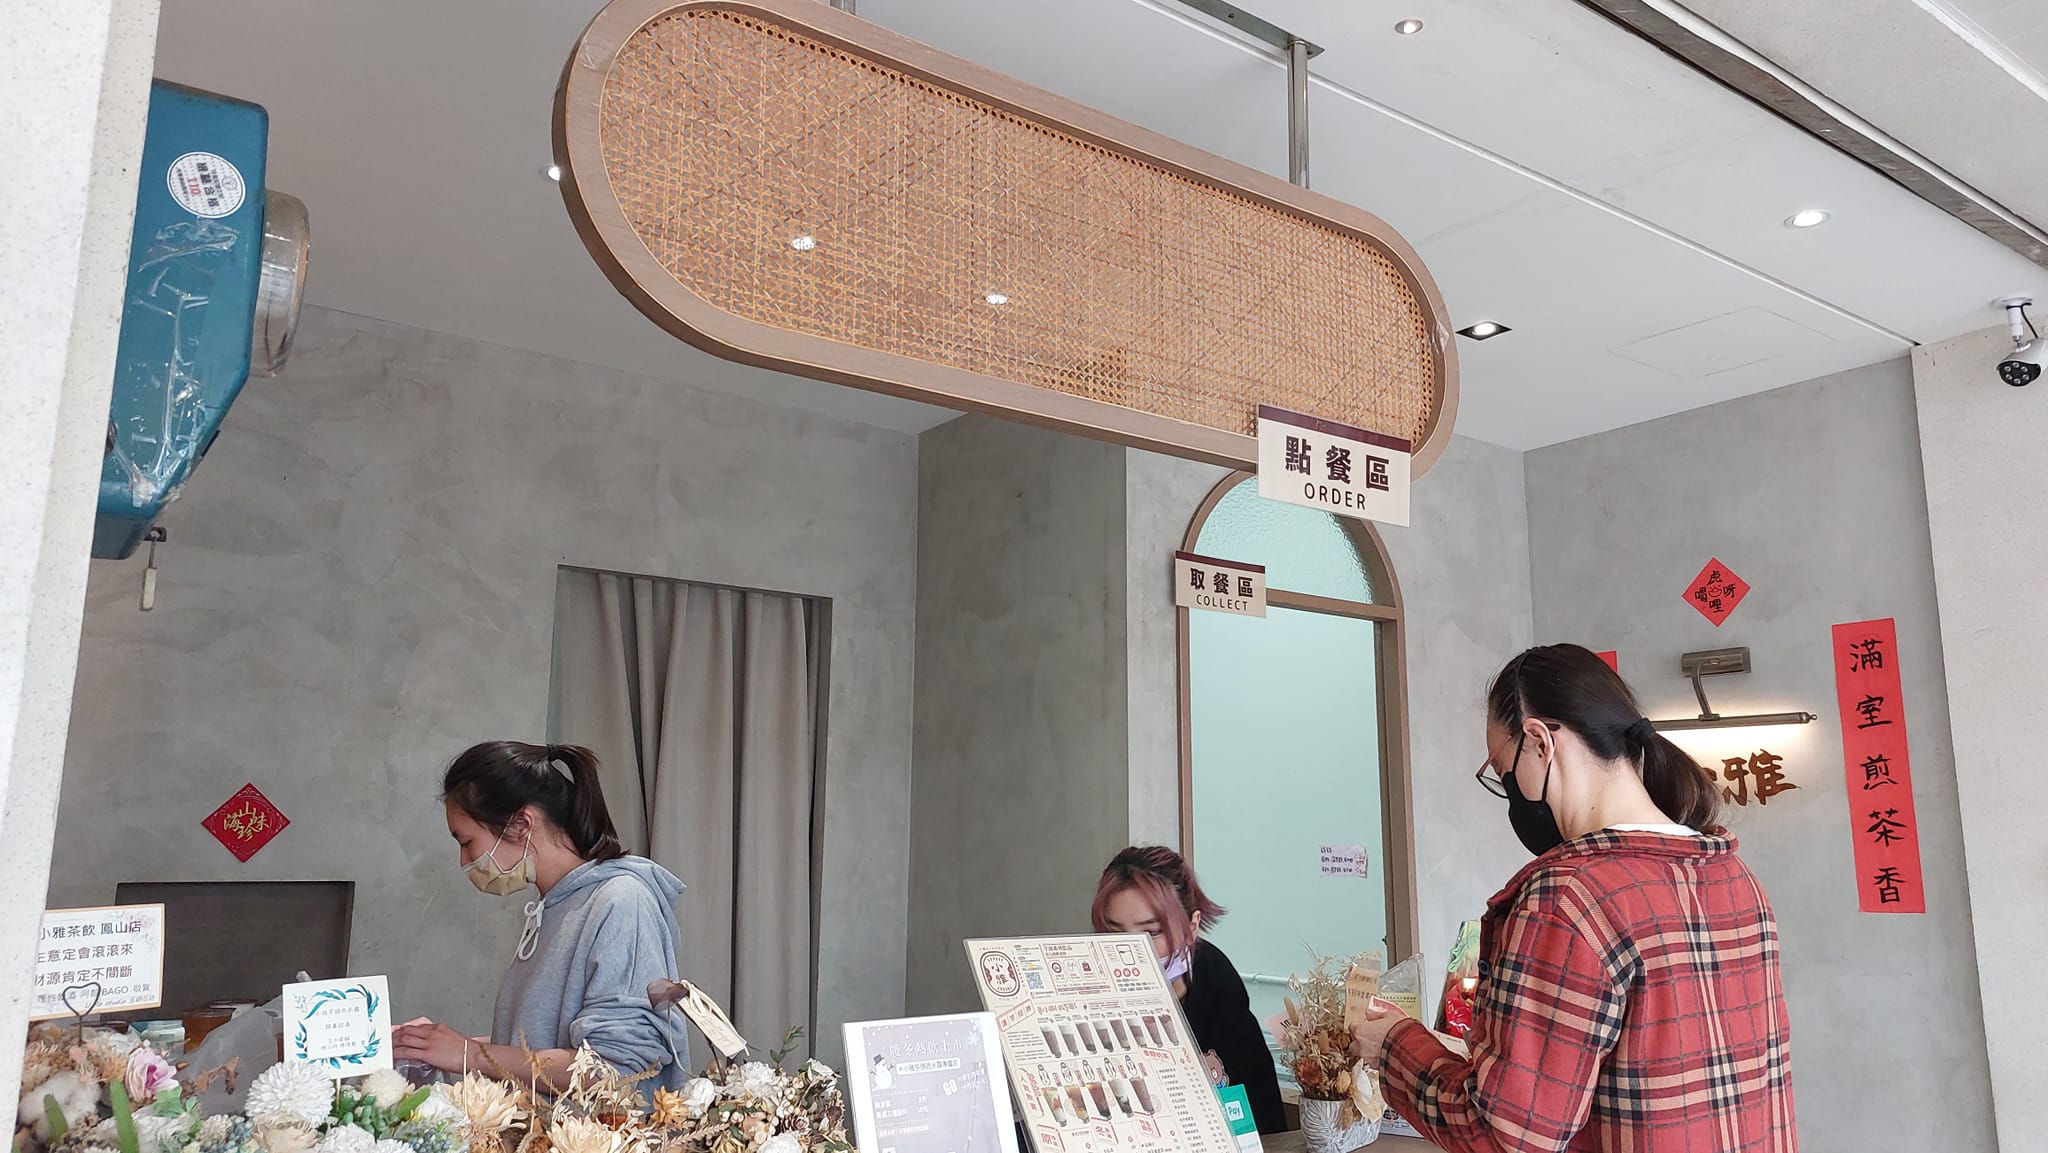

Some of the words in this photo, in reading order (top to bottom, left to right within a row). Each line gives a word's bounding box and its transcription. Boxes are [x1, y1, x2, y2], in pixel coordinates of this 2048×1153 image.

[1285, 435, 1390, 492] 點餐區
[1304, 482, 1366, 510] ORDER
[1190, 567, 1254, 598] 取餐區
[1196, 594, 1248, 612] COLLECT
[1702, 748, 1798, 806] 雅
[1849, 638, 1907, 904] 滿室煎茶香
[100, 920, 142, 935] 鳳山店
[101, 986, 129, 996] BAGO
[1227, 1105, 1241, 1117] Pay
